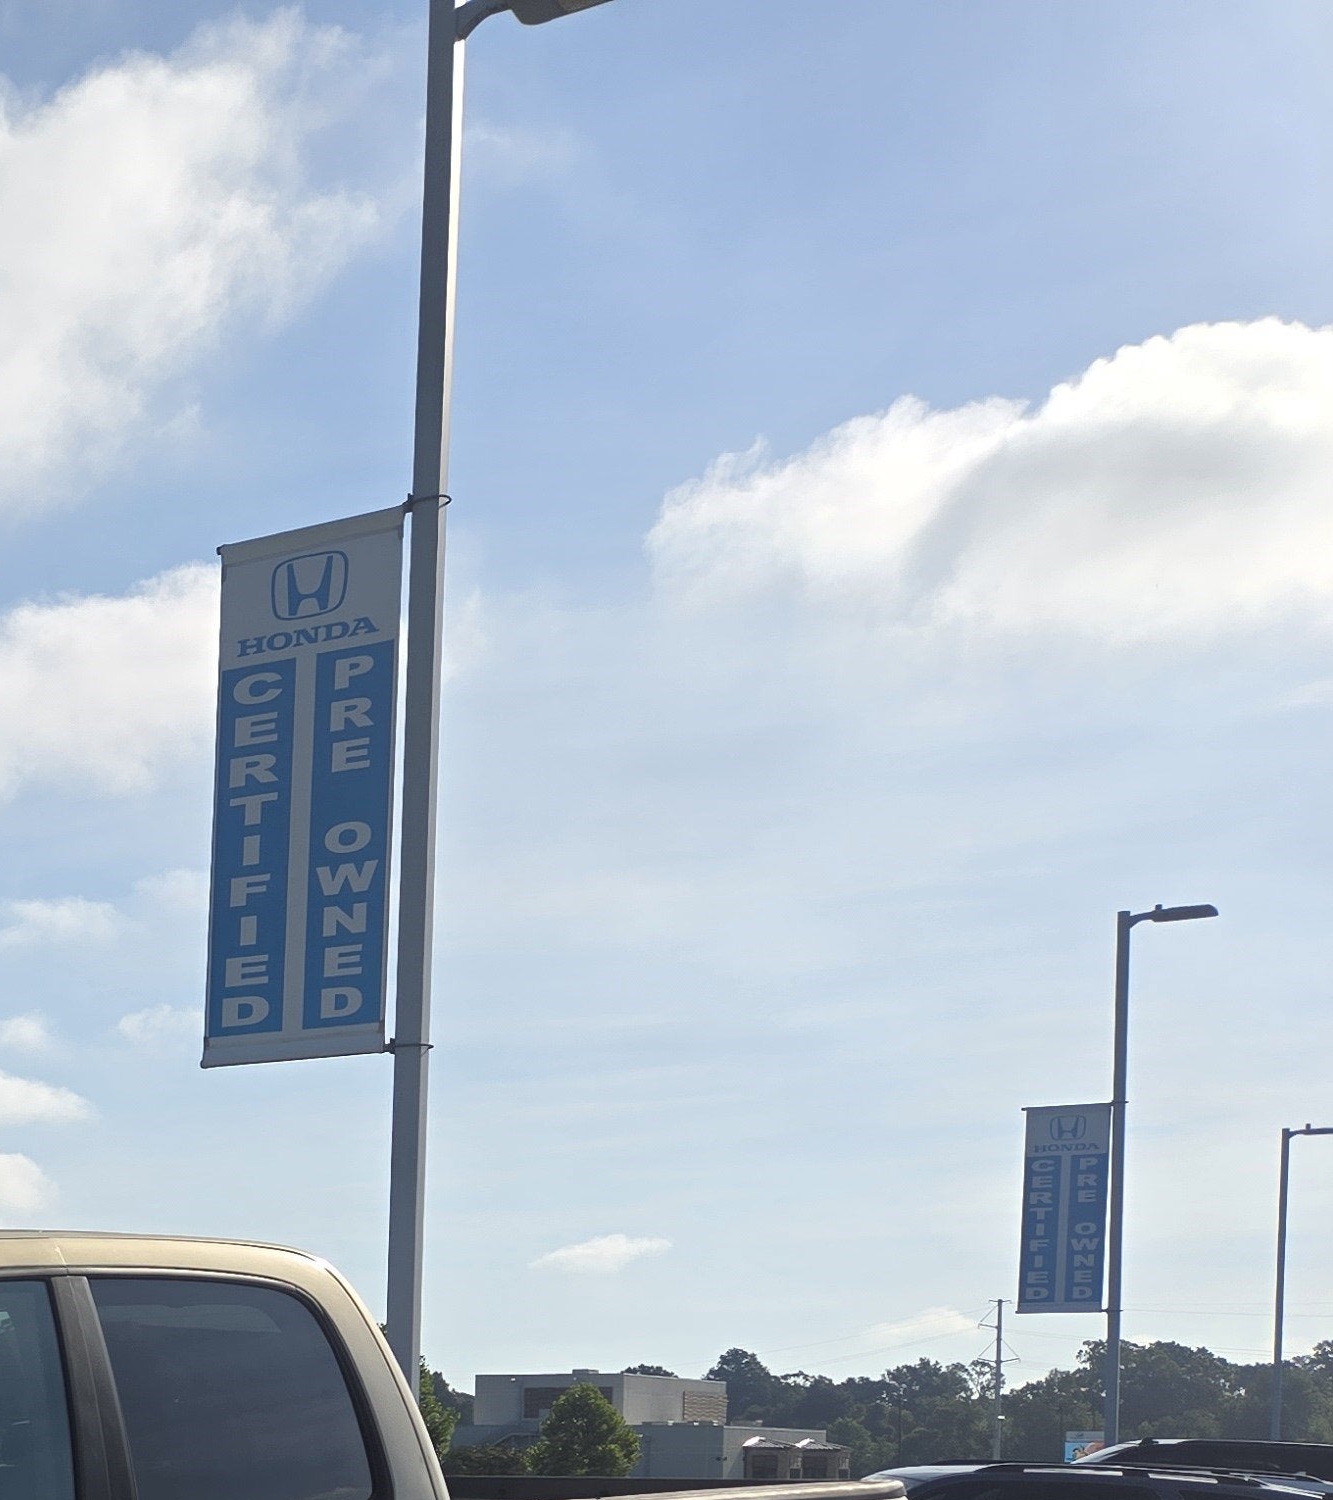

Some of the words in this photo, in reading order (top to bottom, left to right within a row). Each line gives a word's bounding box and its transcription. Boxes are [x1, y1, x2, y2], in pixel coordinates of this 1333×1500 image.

[237, 617, 380, 657] HONDA
[330, 654, 375, 774] PRE
[221, 671, 283, 1028] CERTIFIED
[316, 821, 379, 1020] OWNED
[1034, 1142, 1100, 1153] HONDA
[1077, 1157, 1098, 1203] PRE
[1025, 1159, 1055, 1300] CERTIFIED
[1071, 1222, 1100, 1299] OWNED
